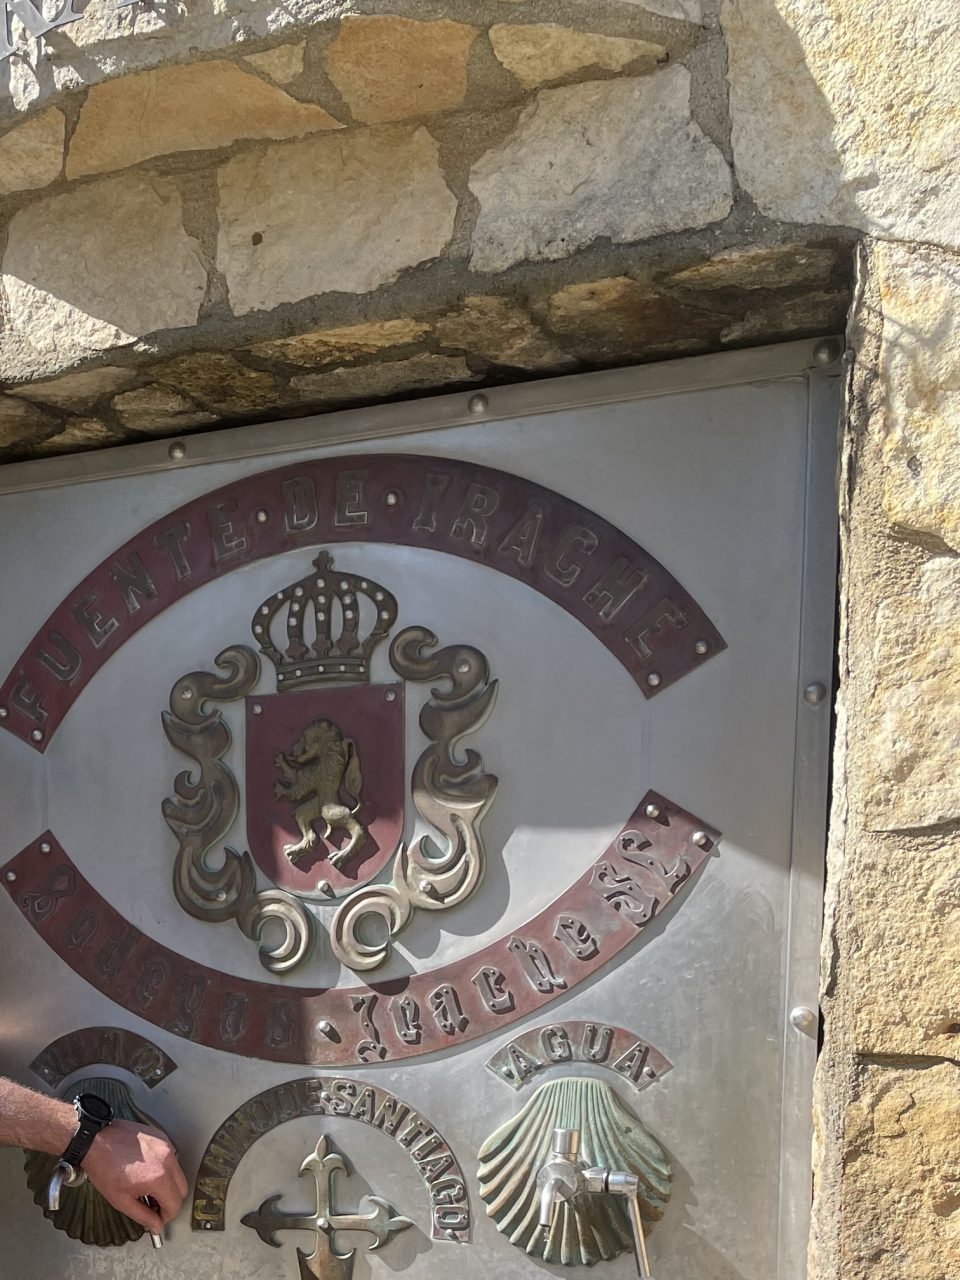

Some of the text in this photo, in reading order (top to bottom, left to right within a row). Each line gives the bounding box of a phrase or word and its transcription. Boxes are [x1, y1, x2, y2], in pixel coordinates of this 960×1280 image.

[10, 470, 690, 725] FUENTE DE IRACHE
[507, 1021, 652, 1087] AGUA
[330, 1078, 470, 1231] SANTIAGO
